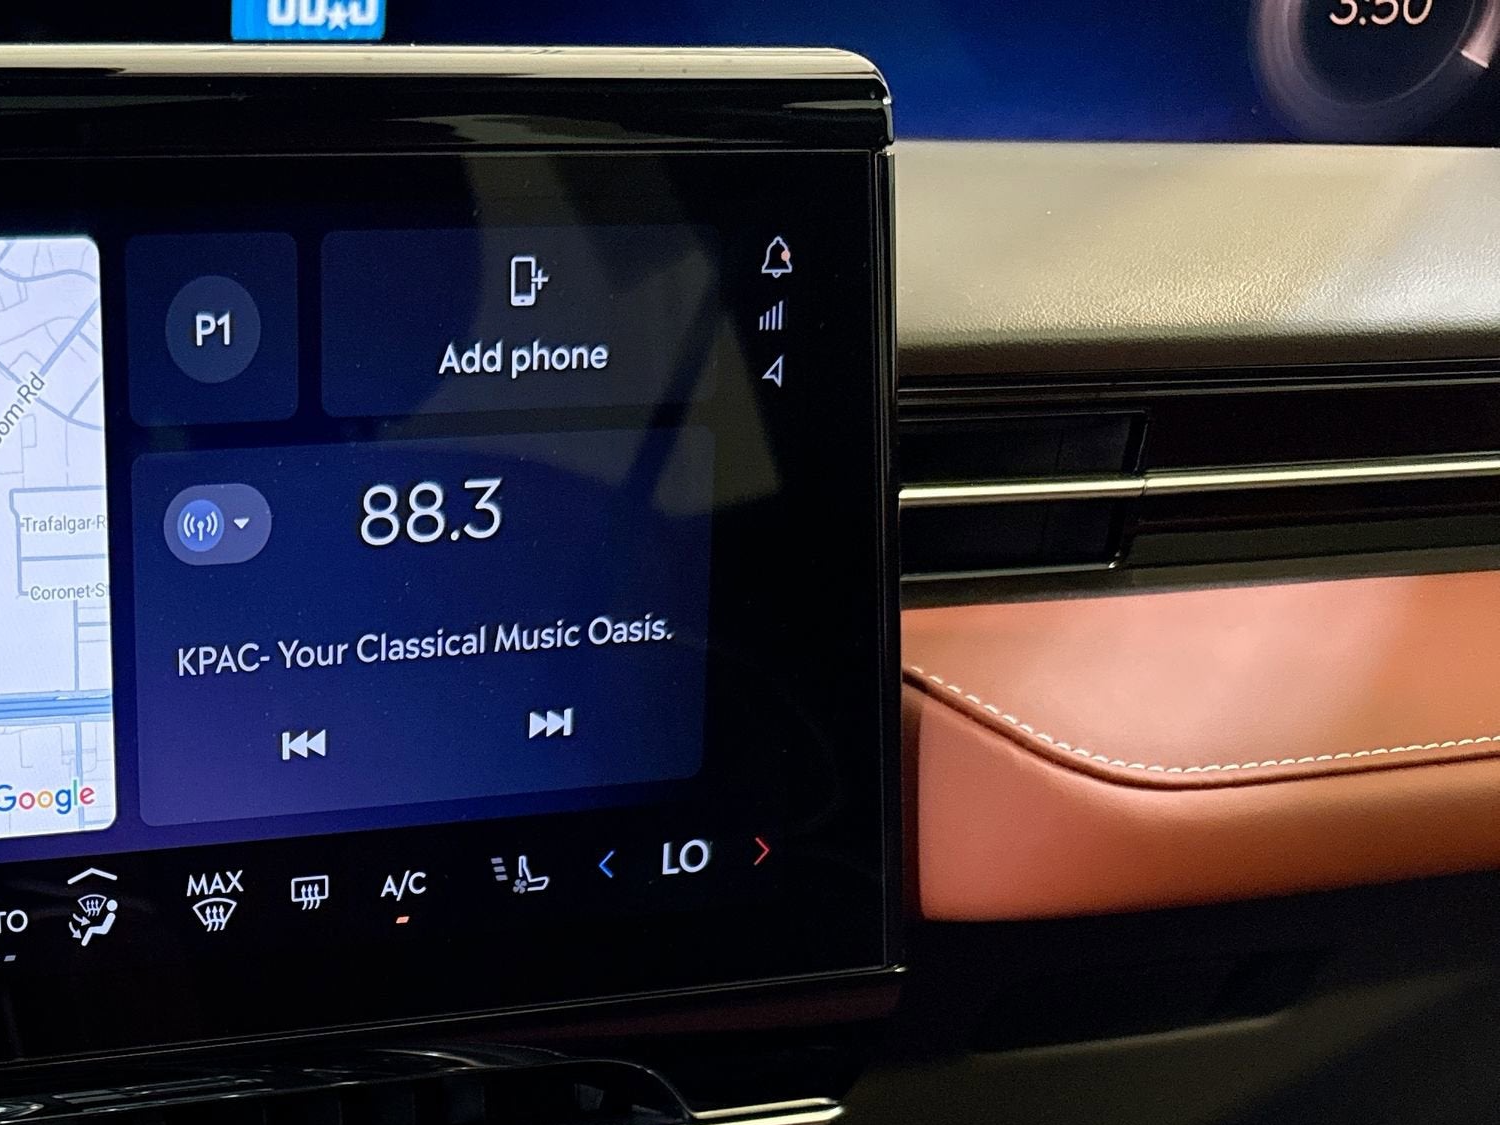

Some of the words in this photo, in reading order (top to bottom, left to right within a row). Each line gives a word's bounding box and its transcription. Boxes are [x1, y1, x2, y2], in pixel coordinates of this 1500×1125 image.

[195, 313, 232, 347] P1
[439, 341, 501, 375] Add
[511, 340, 609, 379] phone
[17, 371, 45, 405] Rd
[22, 515, 92, 535] Trafalgar
[360, 478, 502, 547] 88.3
[30, 584, 91, 601] Coronet
[177, 643, 270, 677] KPAC-
[278, 638, 349, 669] Your
[356, 625, 486, 662] Classical
[494, 618, 580, 653] Music
[587, 612, 674, 646] Oasis.
[661, 839, 710, 875] LO
[186, 870, 244, 897] MAX
[380, 870, 427, 901] A/C
